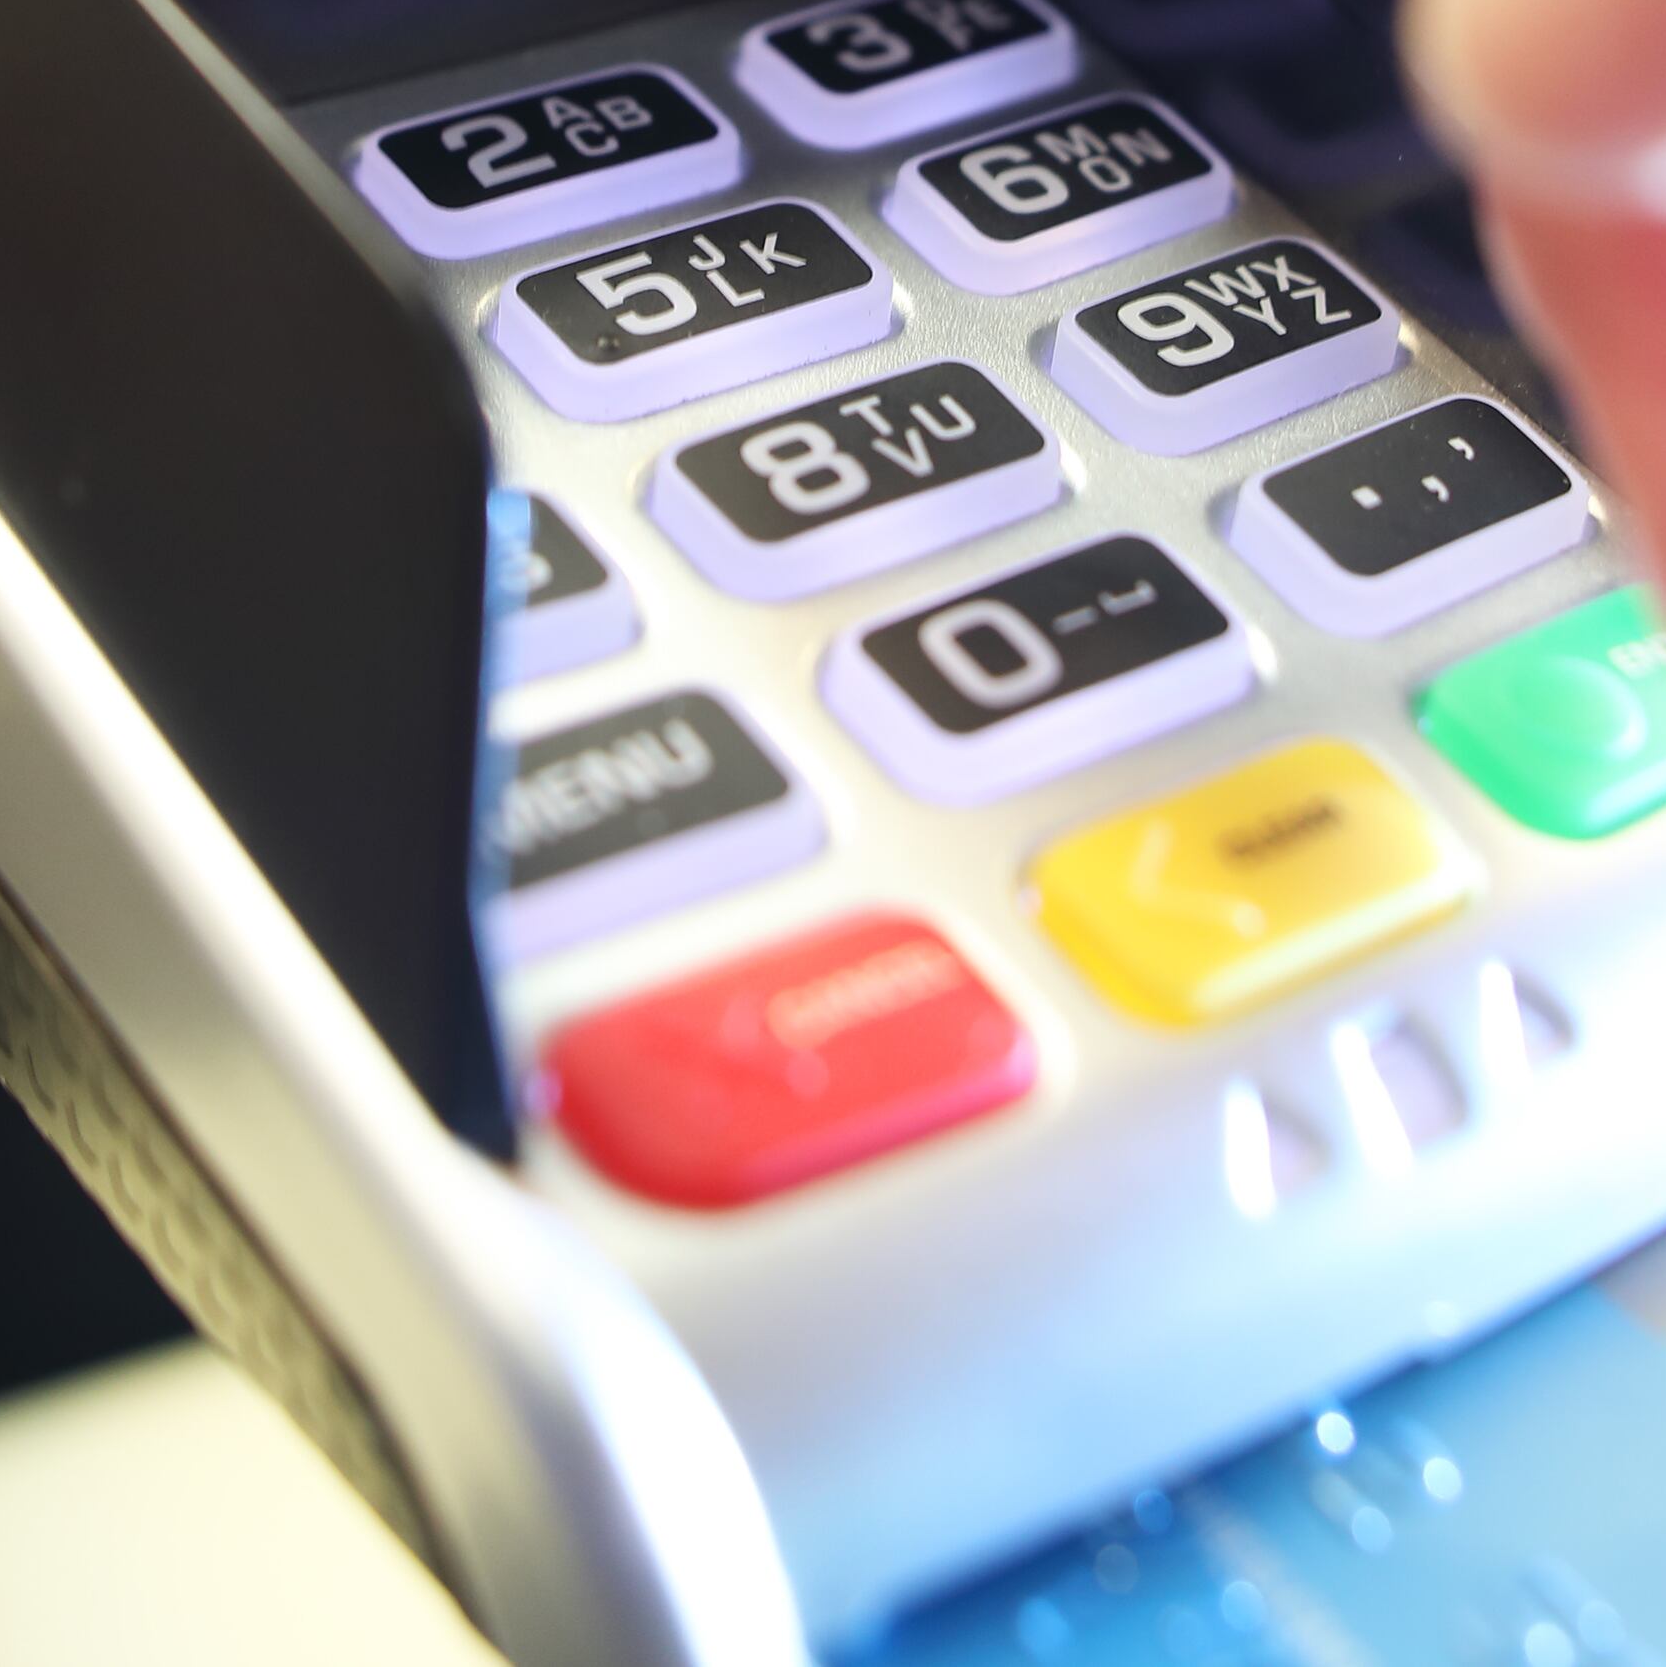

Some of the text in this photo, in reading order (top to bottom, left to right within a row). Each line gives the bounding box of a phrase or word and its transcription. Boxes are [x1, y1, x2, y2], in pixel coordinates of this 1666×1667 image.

[808, 14, 912, 72] 3
[442, 114, 556, 188] 2
[959, 146, 1071, 214] 6
[576, 251, 698, 335] 5
[1117, 291, 1235, 367] 9
[739, 421, 872, 515] 8
[918, 599, 1064, 710] 0
[483, 717, 714, 855] MENU
